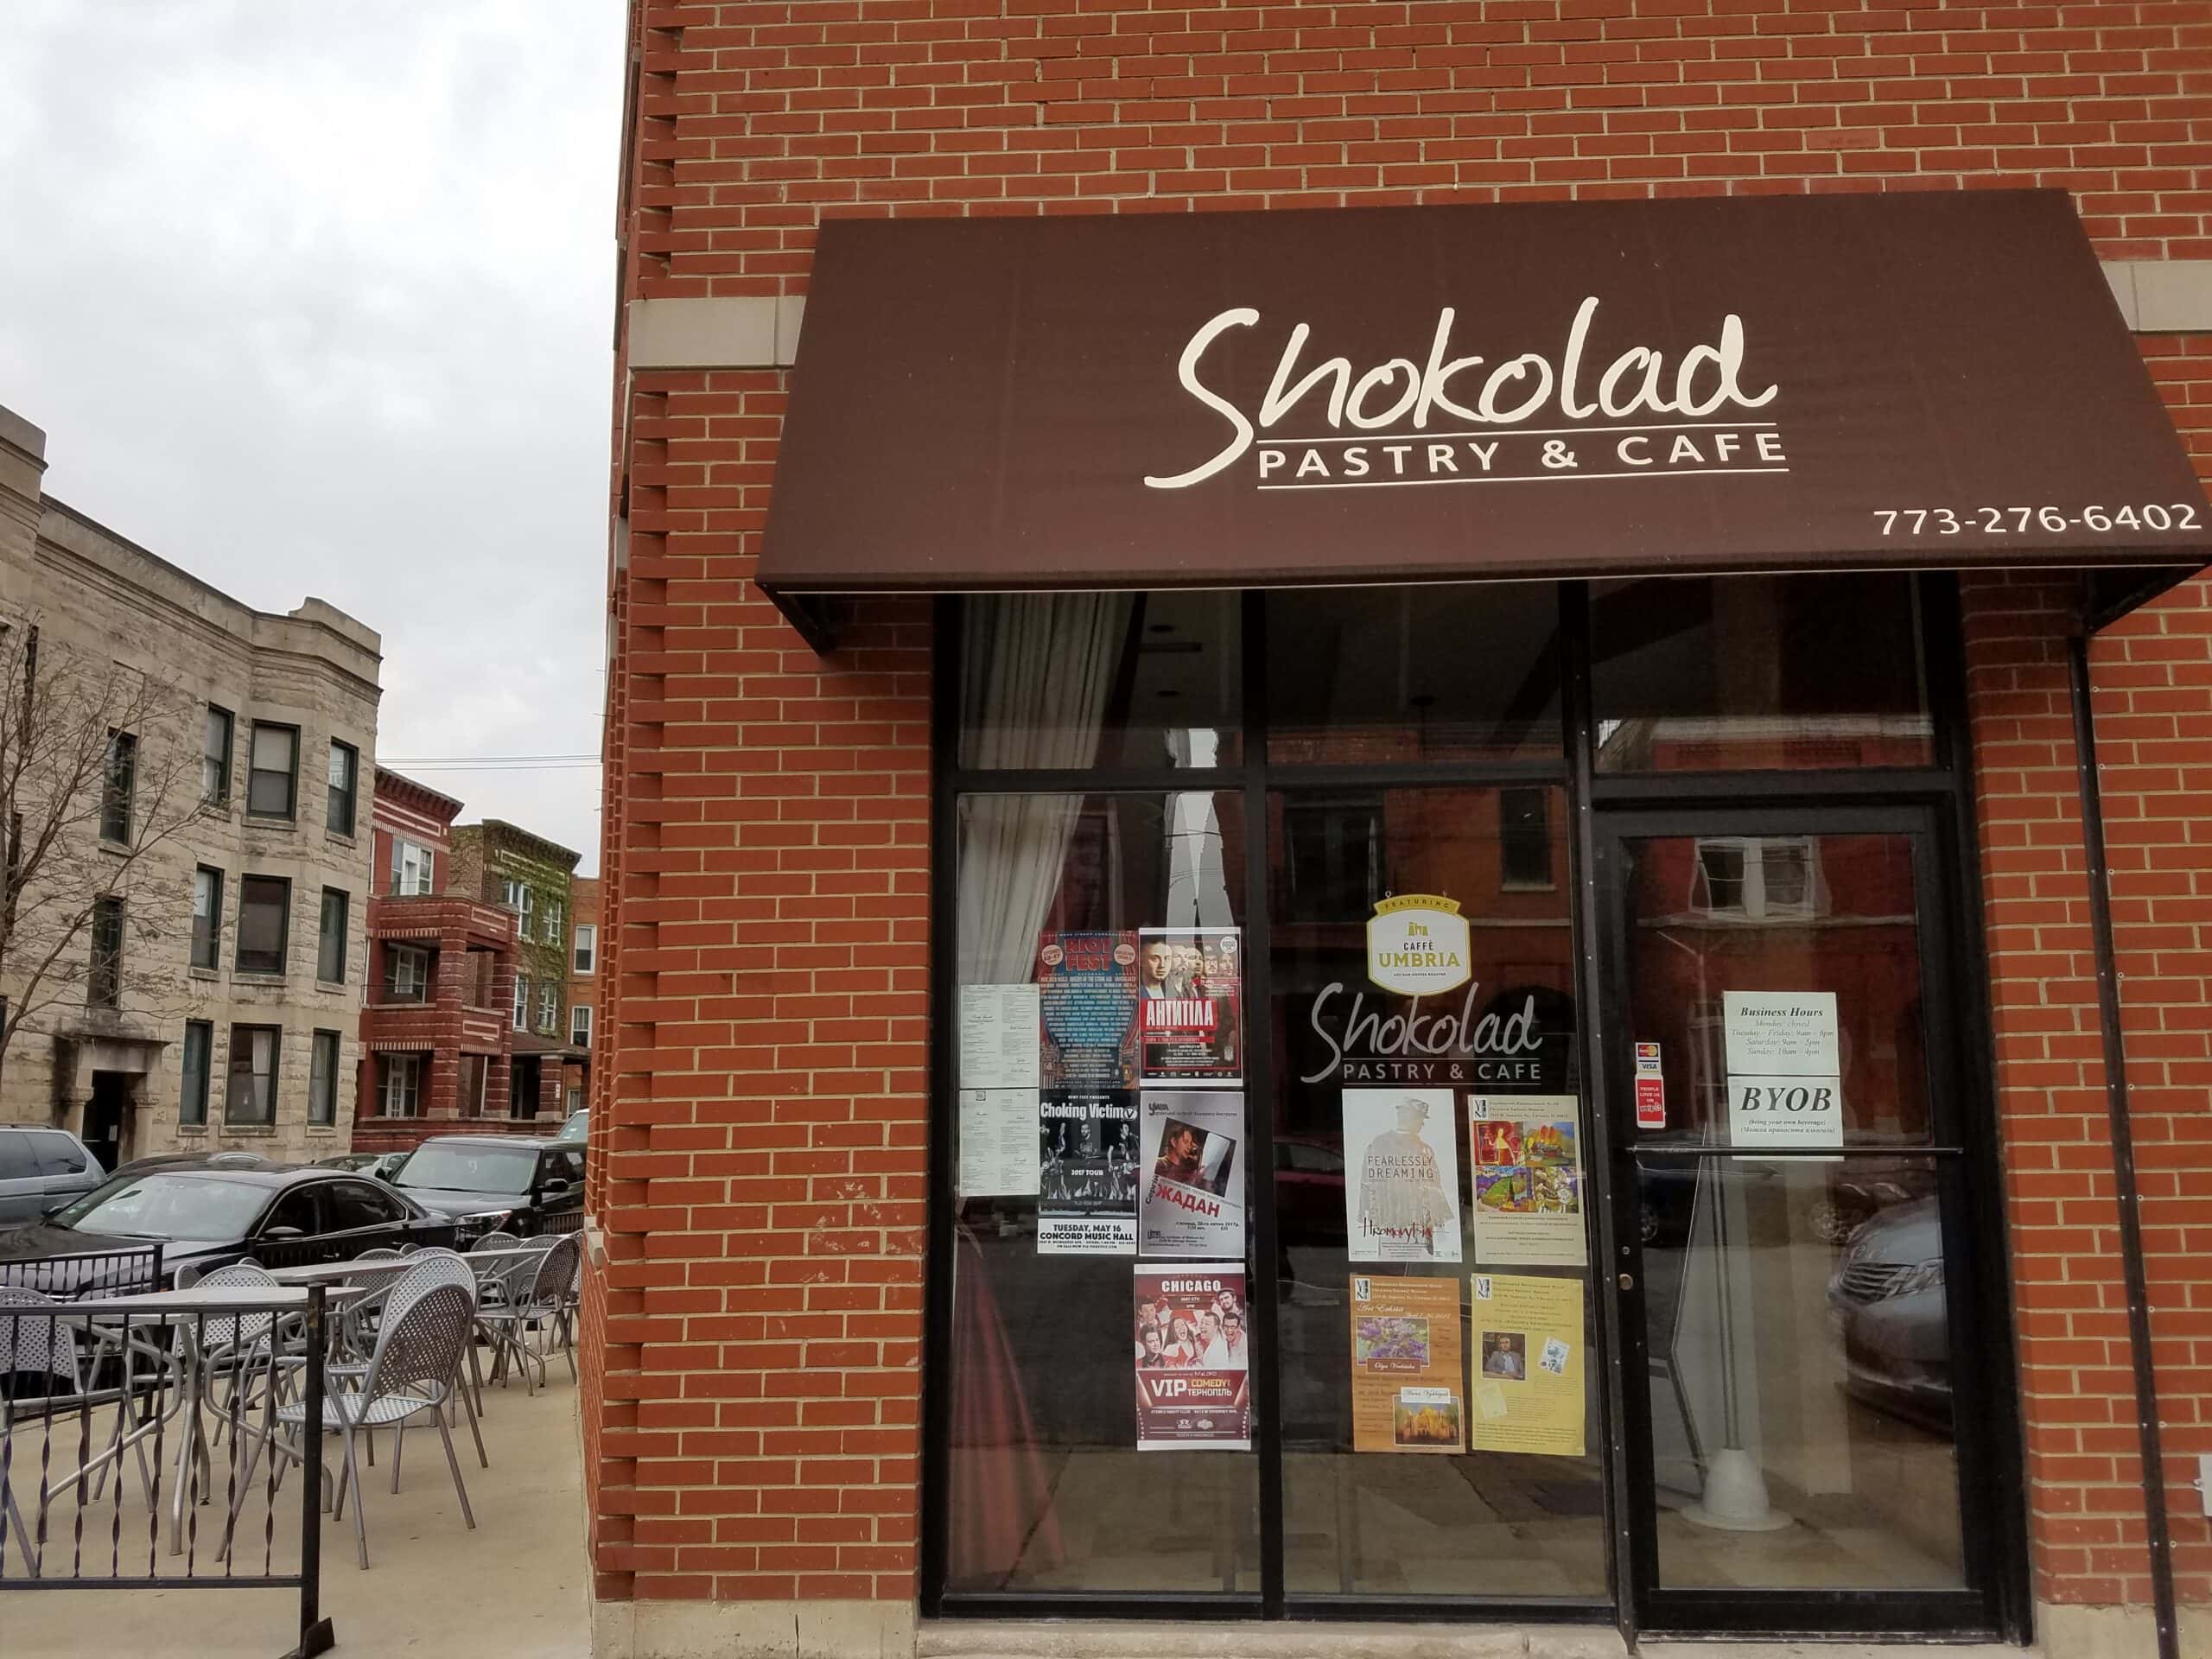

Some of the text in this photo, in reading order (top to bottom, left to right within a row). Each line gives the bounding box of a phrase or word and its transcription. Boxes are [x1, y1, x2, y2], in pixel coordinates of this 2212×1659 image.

[1144, 296, 1778, 489] Shokolad
[1259, 432, 1787, 478] PASTRY & CAFE
[1873, 504, 2202, 536] 773-276-6402
[1384, 899, 1450, 912] FEATURING
[1064, 954, 1113, 972] FEST
[1378, 952, 1461, 968] UMBRIA
[1146, 1000, 1215, 1027] АНТИТІЛА
[1740, 1007, 1824, 1017] Business Hours
[1300, 982, 1543, 1083] Shokolad
[1344, 1064, 1541, 1079] PASTRY & CAFE
[1739, 1087, 1832, 1112] BYOB
[1040, 1102, 1124, 1121] Choking Victim
[1368, 1155, 1433, 1166] FEARLESSLY
[1368, 1167, 1434, 1179] DREAMING
[1155, 1183, 1220, 1218] ЖАДАН
[1053, 1224, 1091, 1232] TUESDAY,
[1161, 1280, 1222, 1293] CHICAGO
[1150, 1379, 1188, 1397] VIP
[1187, 1389, 1233, 1397] ТЕРНОПІЛЬ
